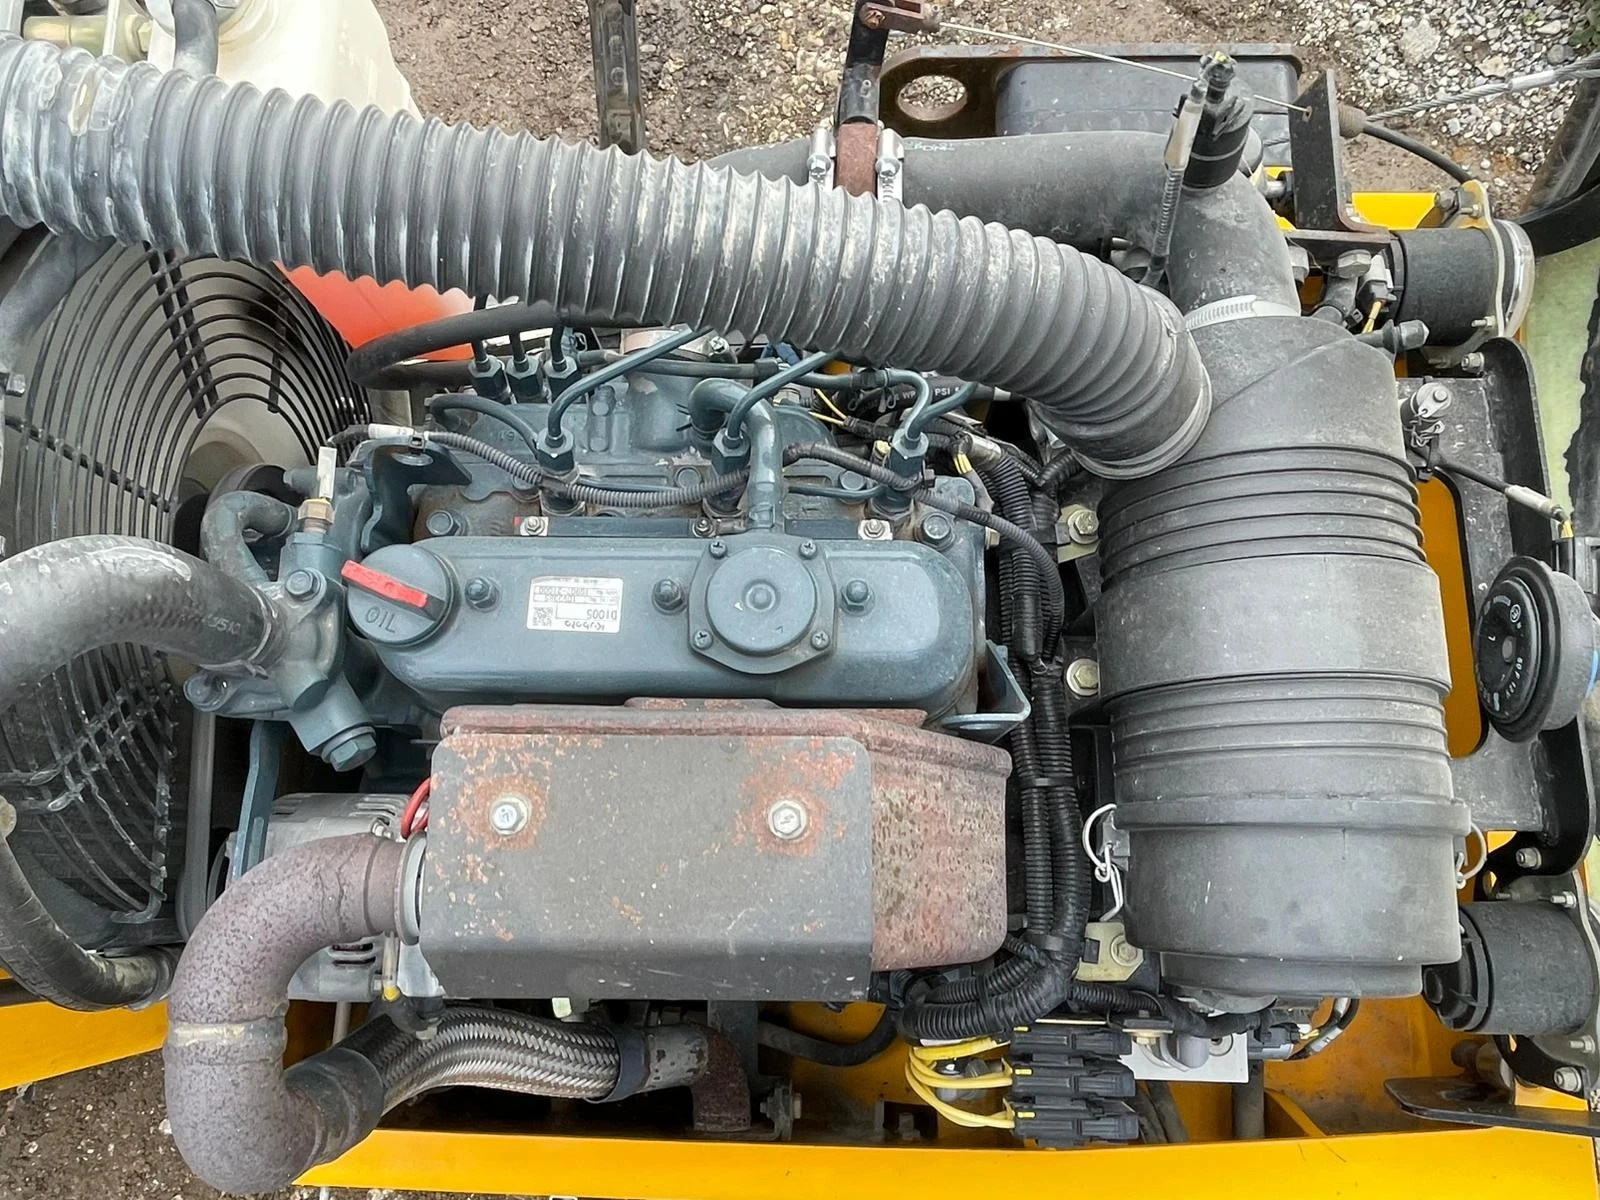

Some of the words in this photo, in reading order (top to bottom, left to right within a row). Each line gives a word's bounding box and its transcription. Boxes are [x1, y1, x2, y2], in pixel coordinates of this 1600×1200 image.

[935, 387, 951, 397] PSI
[365, 606, 397, 634] OIL
[586, 608, 618, 620] D1005
[564, 619, 605, 631] Kubota
